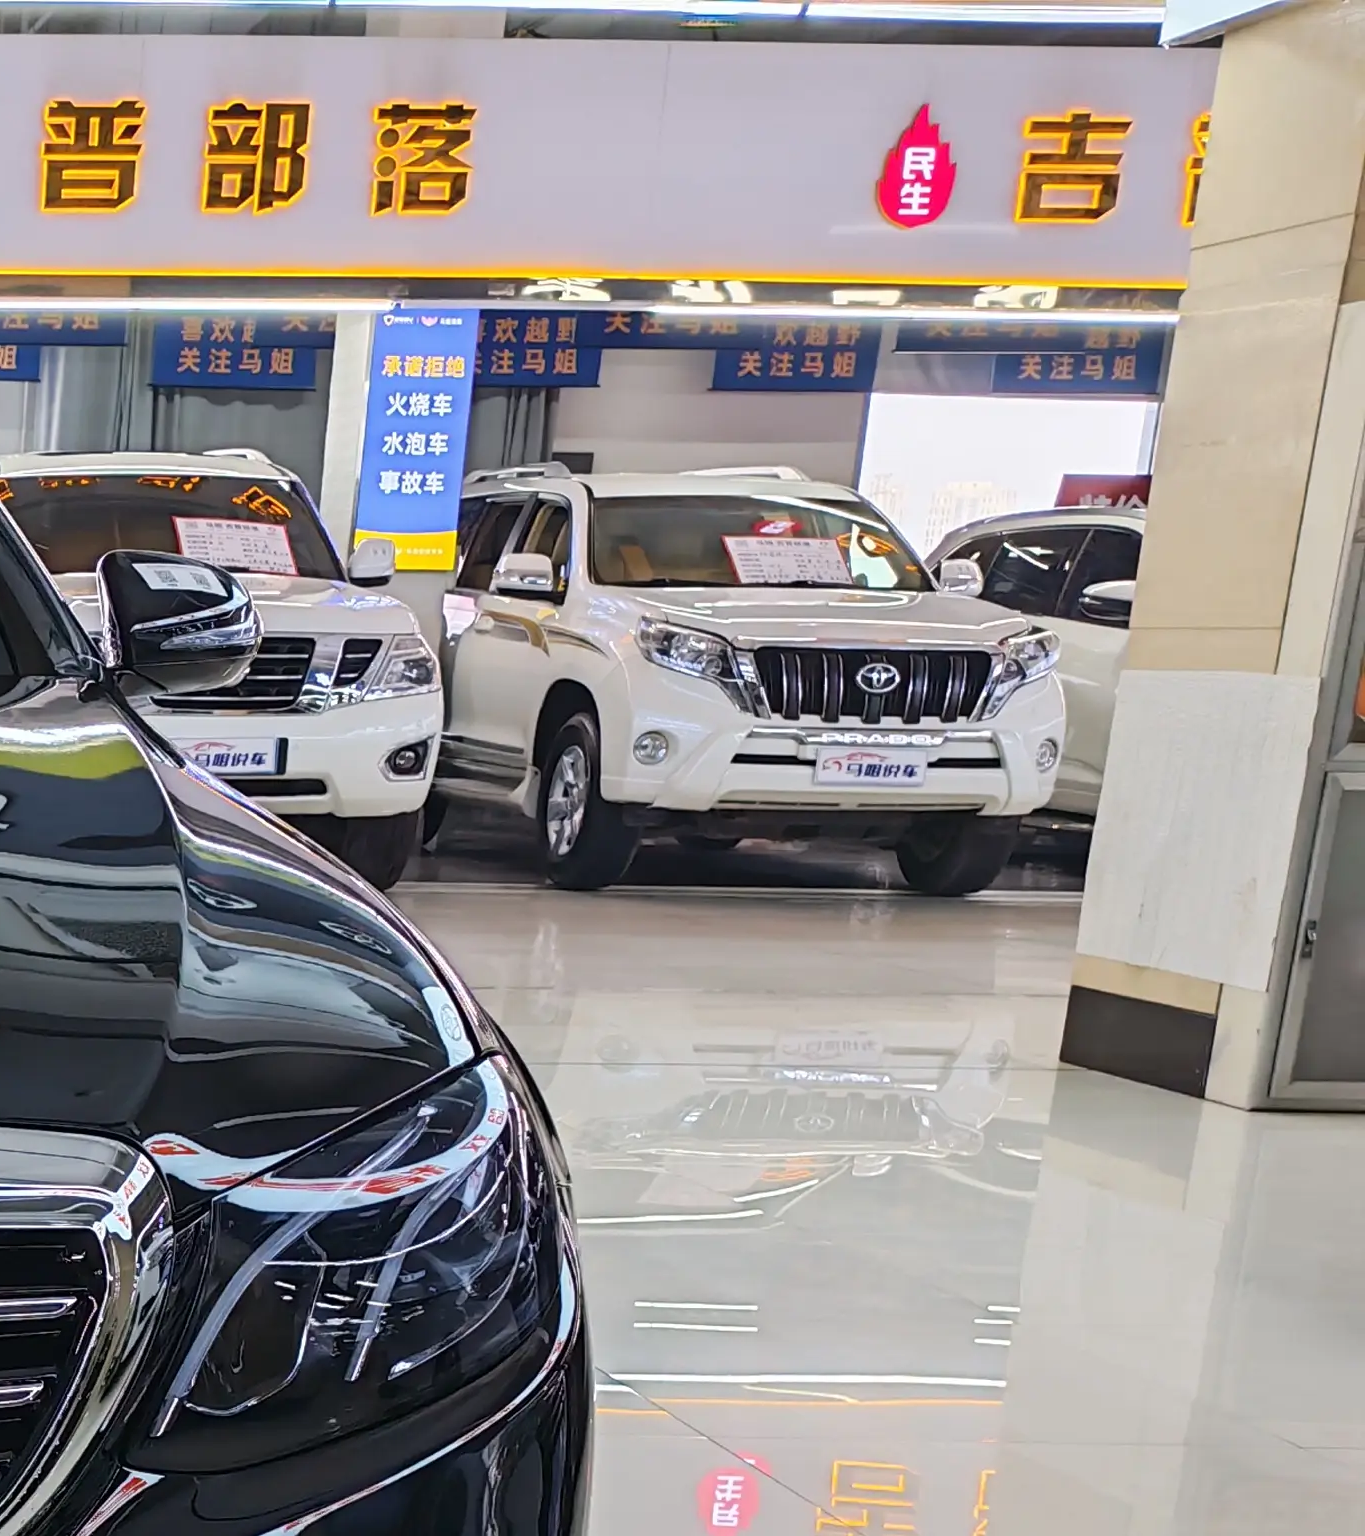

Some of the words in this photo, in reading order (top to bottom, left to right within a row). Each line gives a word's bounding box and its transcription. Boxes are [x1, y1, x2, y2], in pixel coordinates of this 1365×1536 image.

[897, 146, 936, 217] 民生
[176, 346, 294, 374] 关注马姐
[381, 355, 466, 378] 承诺拒绝
[474, 348, 578, 375] 注马姐
[737, 350, 857, 379] 关注马姐
[1018, 354, 1137, 381] 关注马姐
[385, 392, 453, 417] 火烧车
[381, 431, 449, 456] 水泡车
[378, 470, 446, 495] 事故车
[821, 732, 932, 746] PRADO
